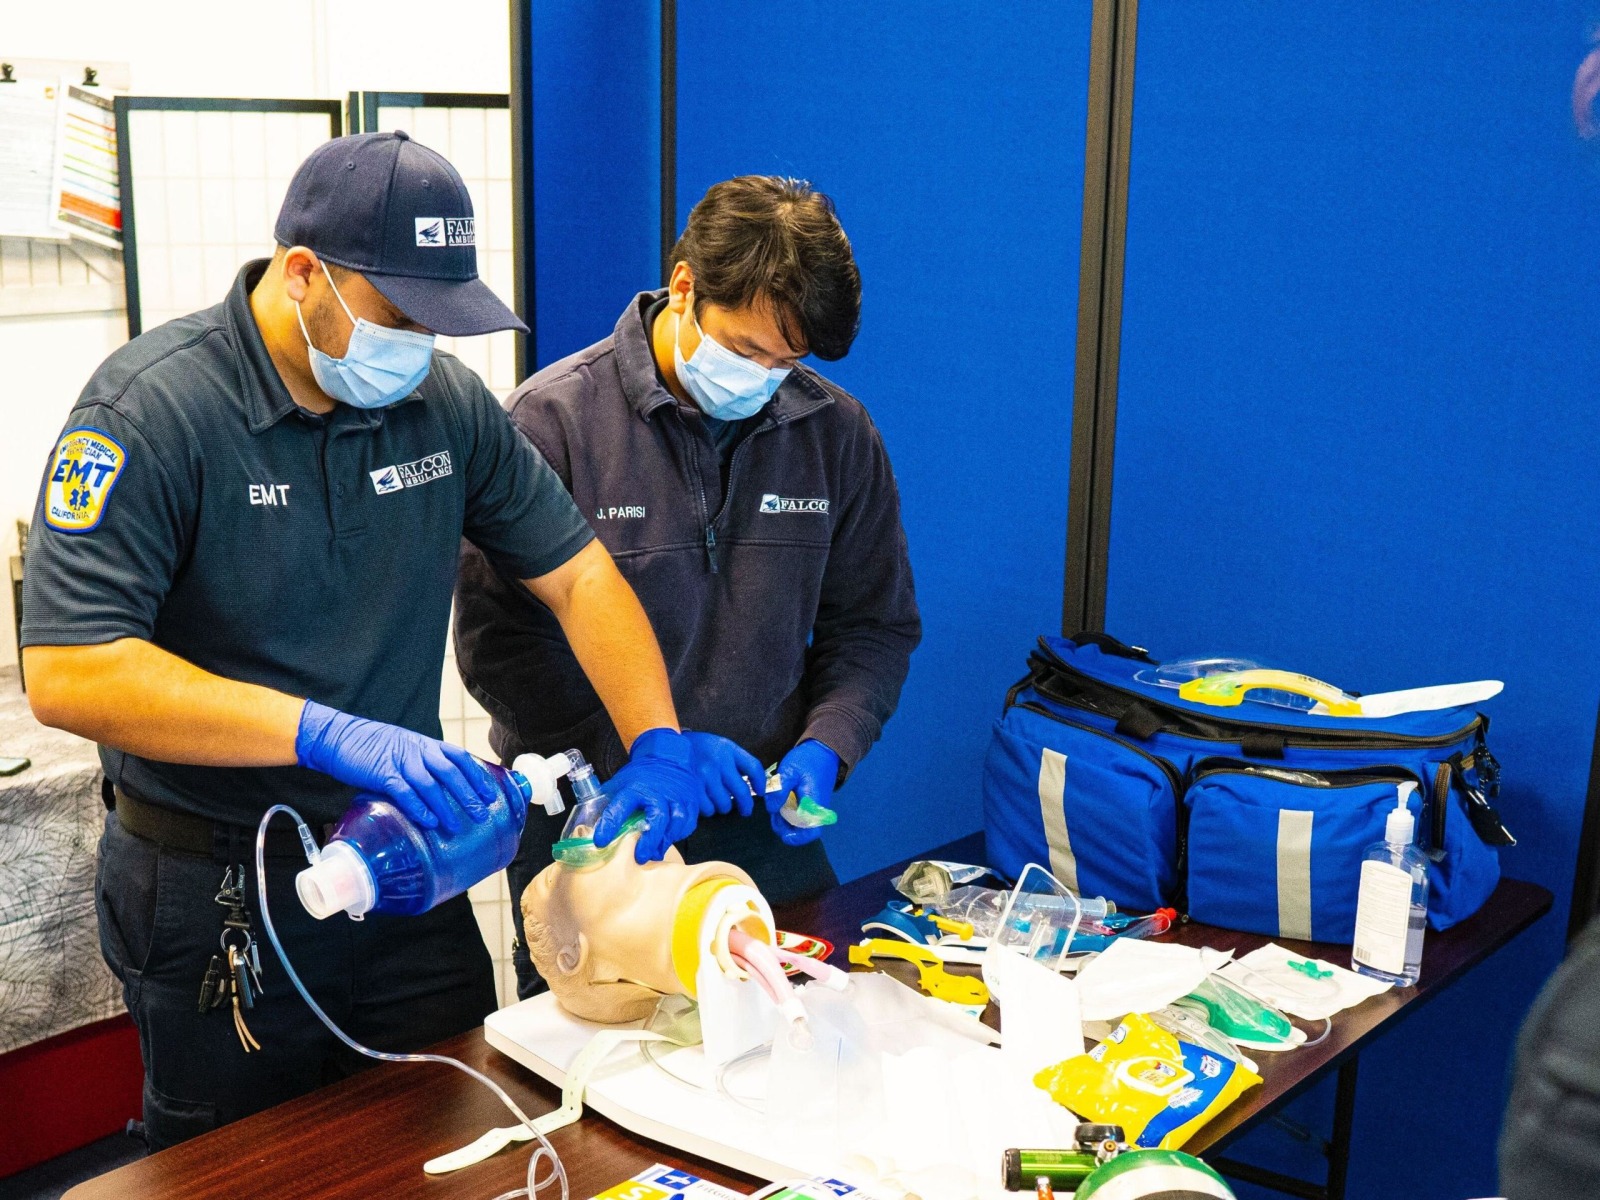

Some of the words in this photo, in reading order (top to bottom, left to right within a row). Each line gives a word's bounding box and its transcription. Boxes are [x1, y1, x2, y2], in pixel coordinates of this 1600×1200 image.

[90, 440, 118, 462] MEDICAL
[52, 458, 116, 488] EMT
[398, 452, 452, 478] FALCON
[248, 484, 290, 506] EMT
[780, 500, 829, 511] FALCO
[52, 506, 90, 520] CALIFORNIA
[596, 508, 606, 520] J.
[608, 506, 646, 520] PARISI
